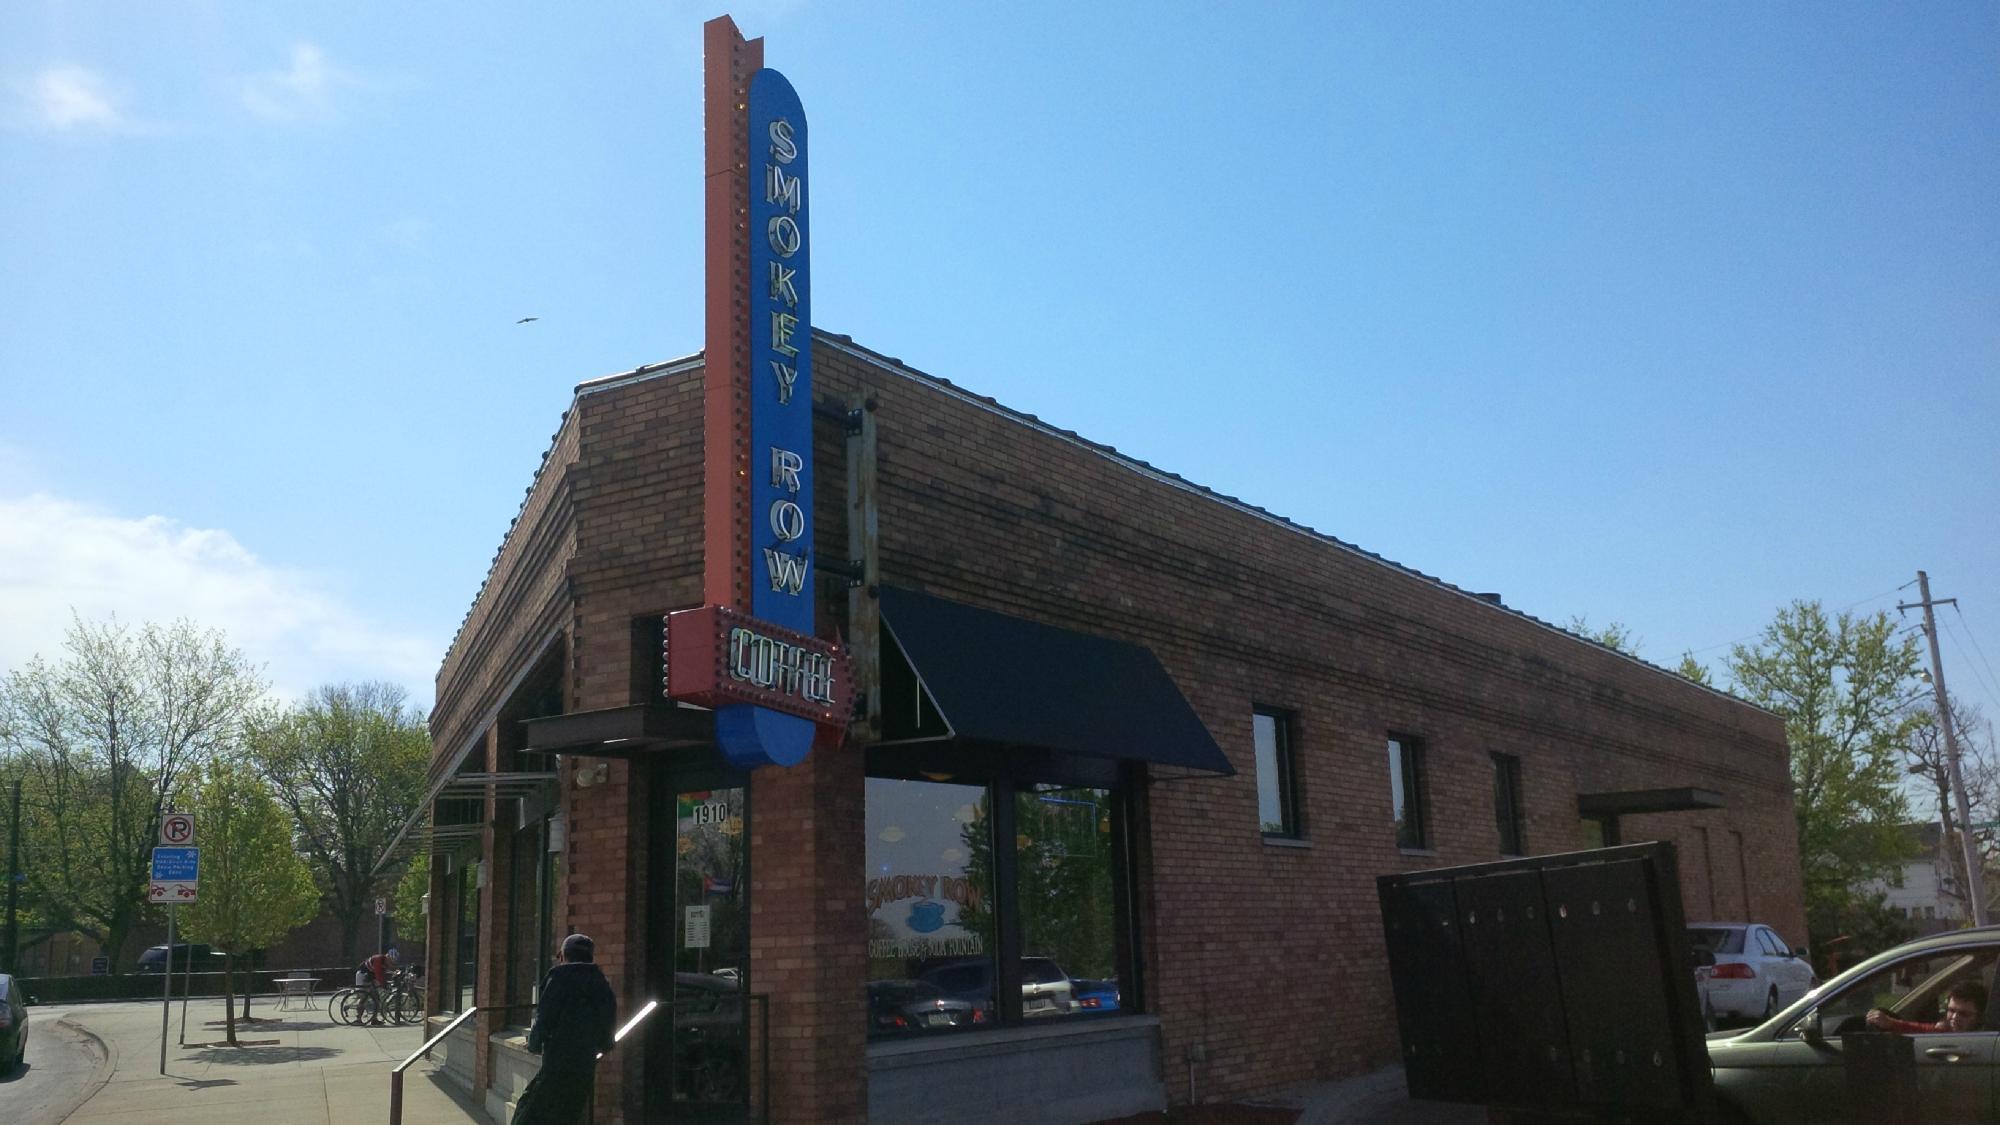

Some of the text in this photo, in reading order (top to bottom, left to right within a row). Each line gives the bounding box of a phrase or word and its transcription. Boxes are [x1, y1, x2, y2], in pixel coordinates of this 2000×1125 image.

[763, 119, 809, 597] SMOKEY ROW
[729, 627, 837, 707] COFFEE
[695, 804, 726, 825] 1910
